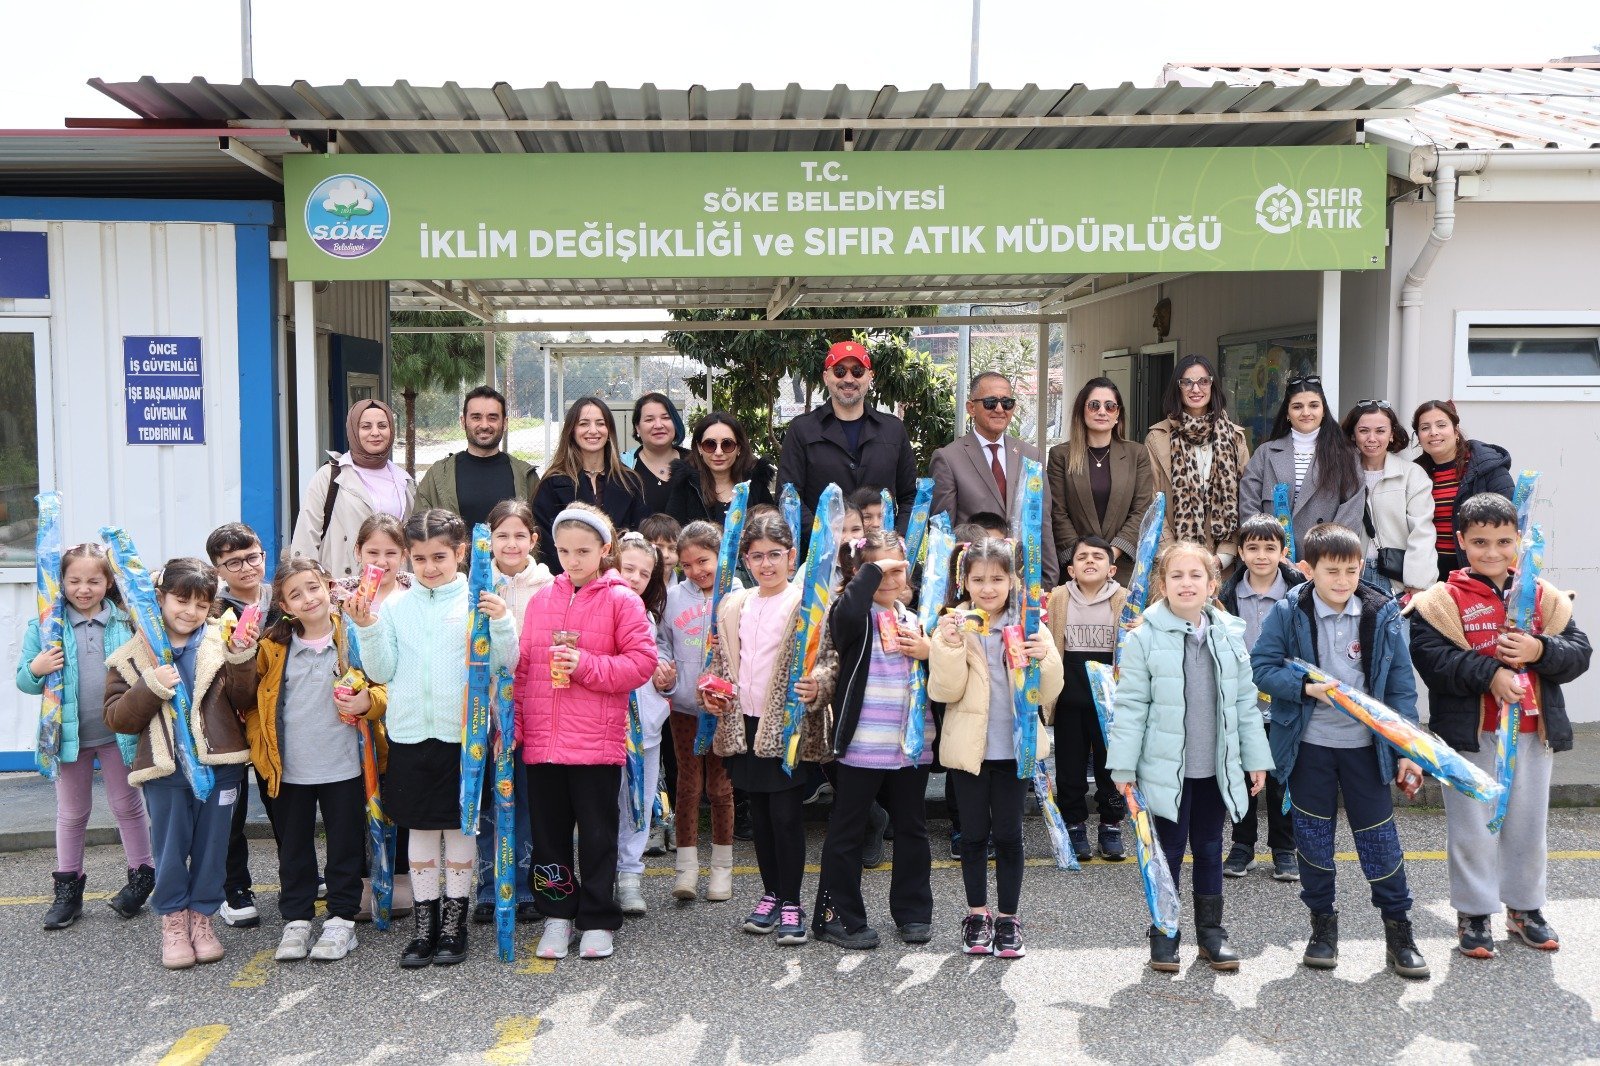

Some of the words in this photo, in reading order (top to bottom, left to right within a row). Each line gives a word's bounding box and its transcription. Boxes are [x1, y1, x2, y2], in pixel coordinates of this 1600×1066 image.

[801, 161, 849, 182] T.C.
[703, 187, 779, 213] SÖKE
[787, 185, 945, 212] BELEDİYESİ
[1306, 187, 1363, 208] SIFIR
[1307, 208, 1362, 229] ATIK
[312, 221, 384, 240] SÖKE
[420, 222, 517, 258] İKLİM
[529, 220, 742, 264] DEĞİŞİKLİĞİ
[752, 233, 794, 256] ve
[804, 226, 895, 256] SIFIR
[904, 225, 986, 255] ATIK
[996, 215, 1222, 254] MÜDÜRLÜĞÜ
[333, 242, 365, 253] Belediyesi
[148, 340, 178, 355] ÖNCE
[130, 358, 140, 374] İŞ
[142, 358, 198, 372] GÜVENLİĞİ
[128, 383, 142, 404] İŞE
[144, 386, 200, 404] BAŞLAMADAN
[144, 404, 187, 421] GÜVENLİK
[138, 424, 180, 440] TEDBİRİNİ
[182, 427, 194, 440] AL
[1066, 624, 1114, 648] NIKE
